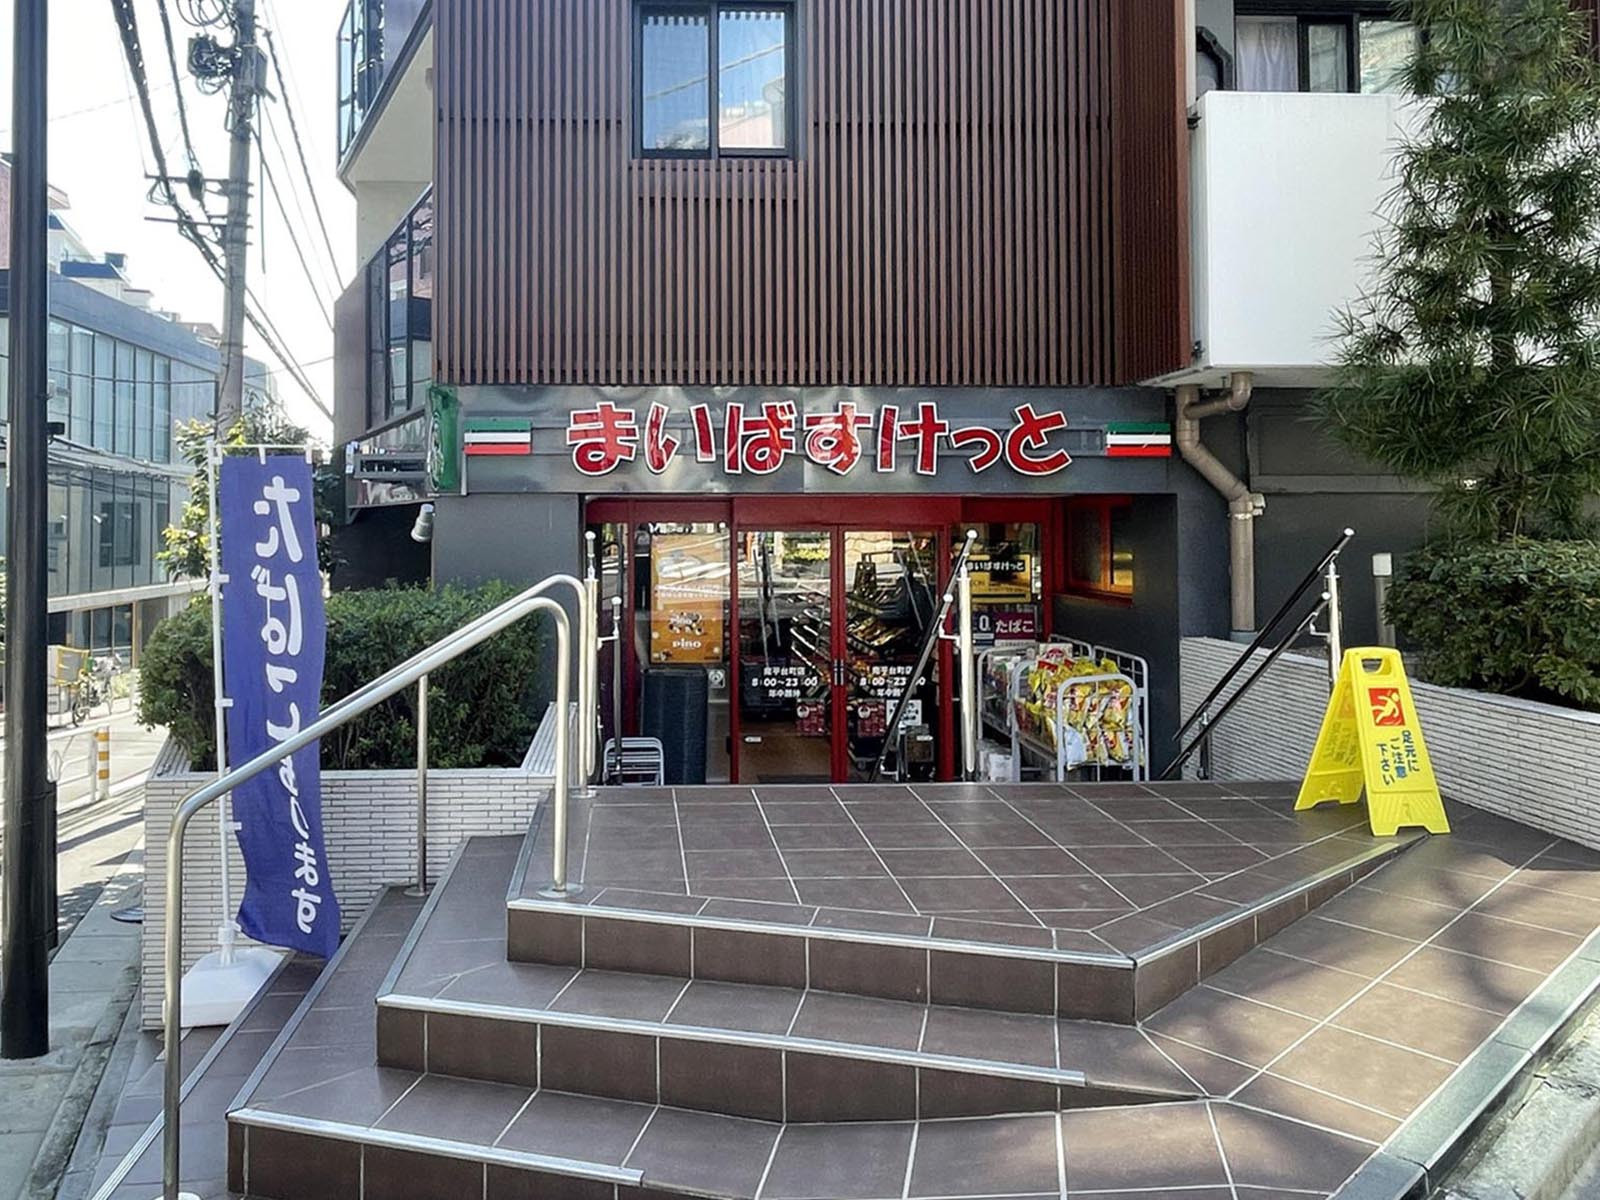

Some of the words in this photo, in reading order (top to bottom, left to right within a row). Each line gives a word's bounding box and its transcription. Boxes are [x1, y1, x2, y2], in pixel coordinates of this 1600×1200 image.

[566, 401, 1073, 477] まいばすけっと
[672, 638, 702, 649] pino
[995, 619, 1034, 633] たばこ
[1376, 743, 1396, 786] 下さい
[1389, 737, 1408, 779] ご注意
[1401, 730, 1421, 772] 足元に
